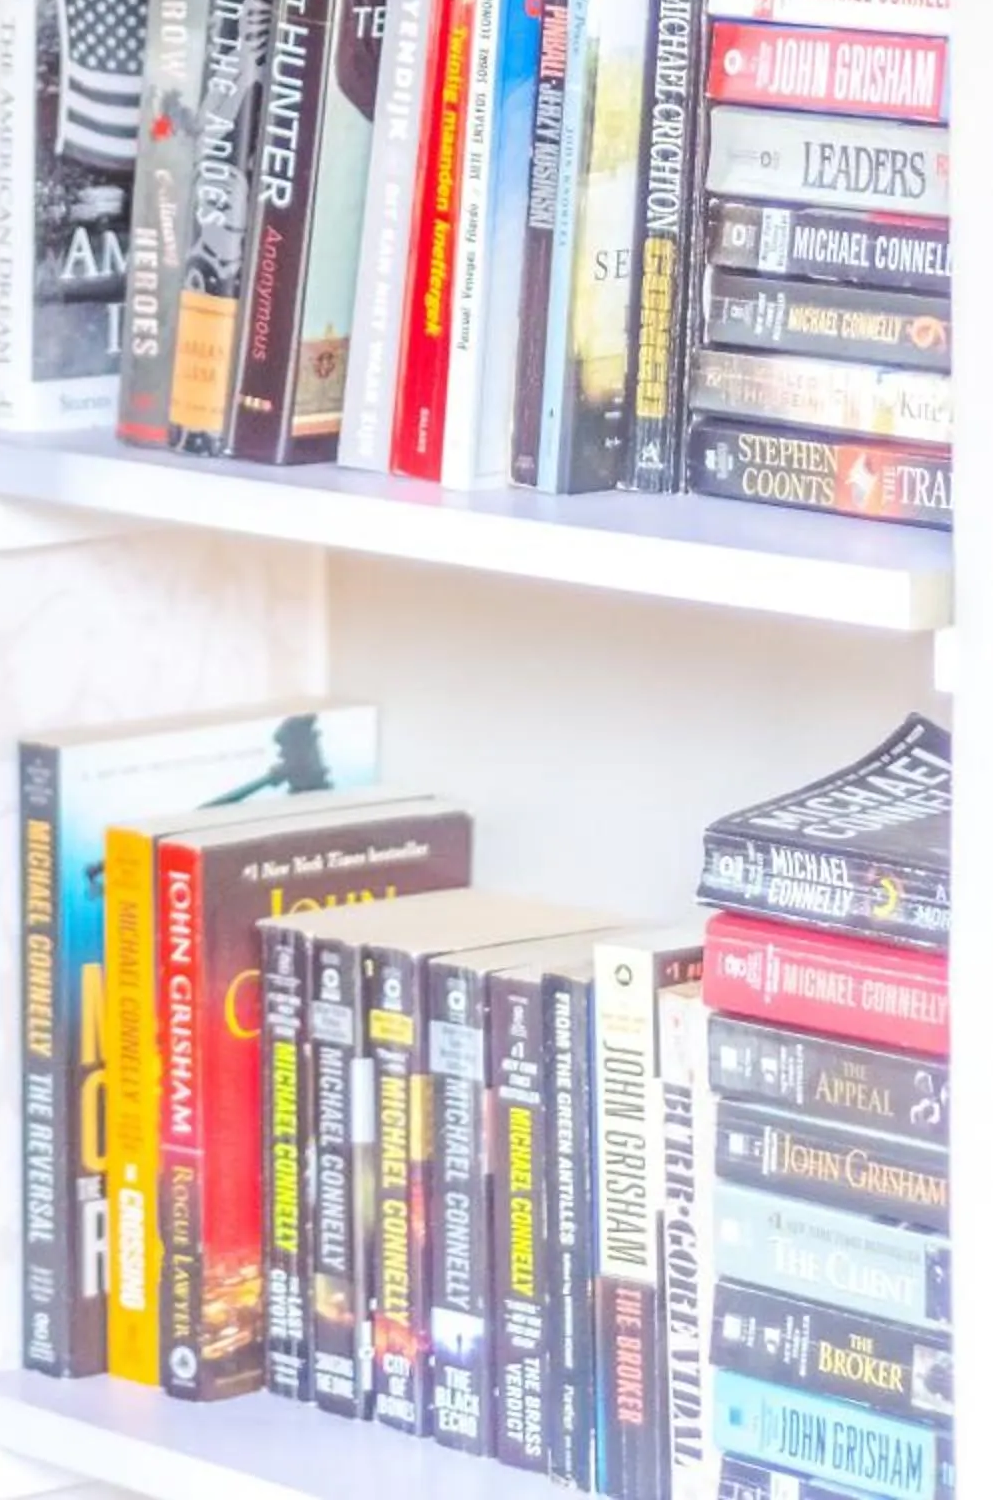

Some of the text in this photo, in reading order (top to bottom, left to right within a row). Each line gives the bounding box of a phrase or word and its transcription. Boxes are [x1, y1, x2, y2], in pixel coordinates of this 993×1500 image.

[444, 25, 468, 103] Twintig
[539, 4, 569, 78] PINBALL
[768, 36, 937, 109] JOHN GRISHAM
[256, 22, 309, 210] HUNTER
[196, 110, 235, 230] ANDES
[436, 111, 456, 211] maanden
[527, 141, 559, 229] KOSINSKI
[646, 103, 687, 232] CRICHTON
[801, 141, 926, 198] LEADERS
[792, 225, 870, 268] MICHAEL
[131, 227, 159, 357] HEROES
[251, 226, 284, 363] Anonymous
[635, 238, 676, 419] CONGO
[787, 303, 902, 344] MICHAEL CONNELLY
[737, 433, 839, 474] STEPHEN
[741, 467, 836, 510] COONTS
[261, 861, 291, 878] New
[293, 854, 324, 875] York
[327, 849, 366, 869] Times
[767, 877, 855, 918] CONNELLY
[771, 846, 855, 889] MICHAEL
[26, 818, 55, 1244] MICHAEL CONNELLY THE REVERSAL
[168, 869, 193, 1135] JOHN GRISHAM
[783, 962, 856, 1007] MICHAEL
[861, 979, 950, 1025] CONNELLY
[118, 899, 145, 1311] MICHAEL CONNELLY CROSSING
[272, 1041, 297, 1138] MICHAEL
[319, 1047, 344, 1147] MICHAEL
[815, 1071, 895, 1117] APPEAL
[843, 1061, 870, 1079] THE
[380, 1076, 406, 1189] MICHAEL
[443, 1077, 469, 1183] MICHAEL
[509, 1107, 532, 1193] MICHAEL
[554, 991, 577, 1245] FROM THE GREEN ANTILLES
[273, 1142, 298, 1254] CONNELLY
[320, 1153, 346, 1270] CONNELLY
[781, 1133, 949, 1206] JOHN GRISHAM
[382, 1198, 408, 1326] CONNELLY
[444, 1191, 470, 1310] CONNELLY
[510, 1197, 534, 1297] CONNELLY
[602, 1039, 648, 1425] JOHN GRISHAM THE BROKER
[769, 1233, 819, 1284] THE
[824, 1249, 916, 1306] CLIENT
[270, 1268, 288, 1340] COYOTE
[849, 1333, 876, 1353] THE
[505, 1363, 523, 1442] VERDICT
[524, 1358, 542, 1457] THE BRASS
[817, 1340, 905, 1393] BROKER
[778, 1405, 827, 1468] JOHN
[831, 1420, 925, 1494] GRISHAM
